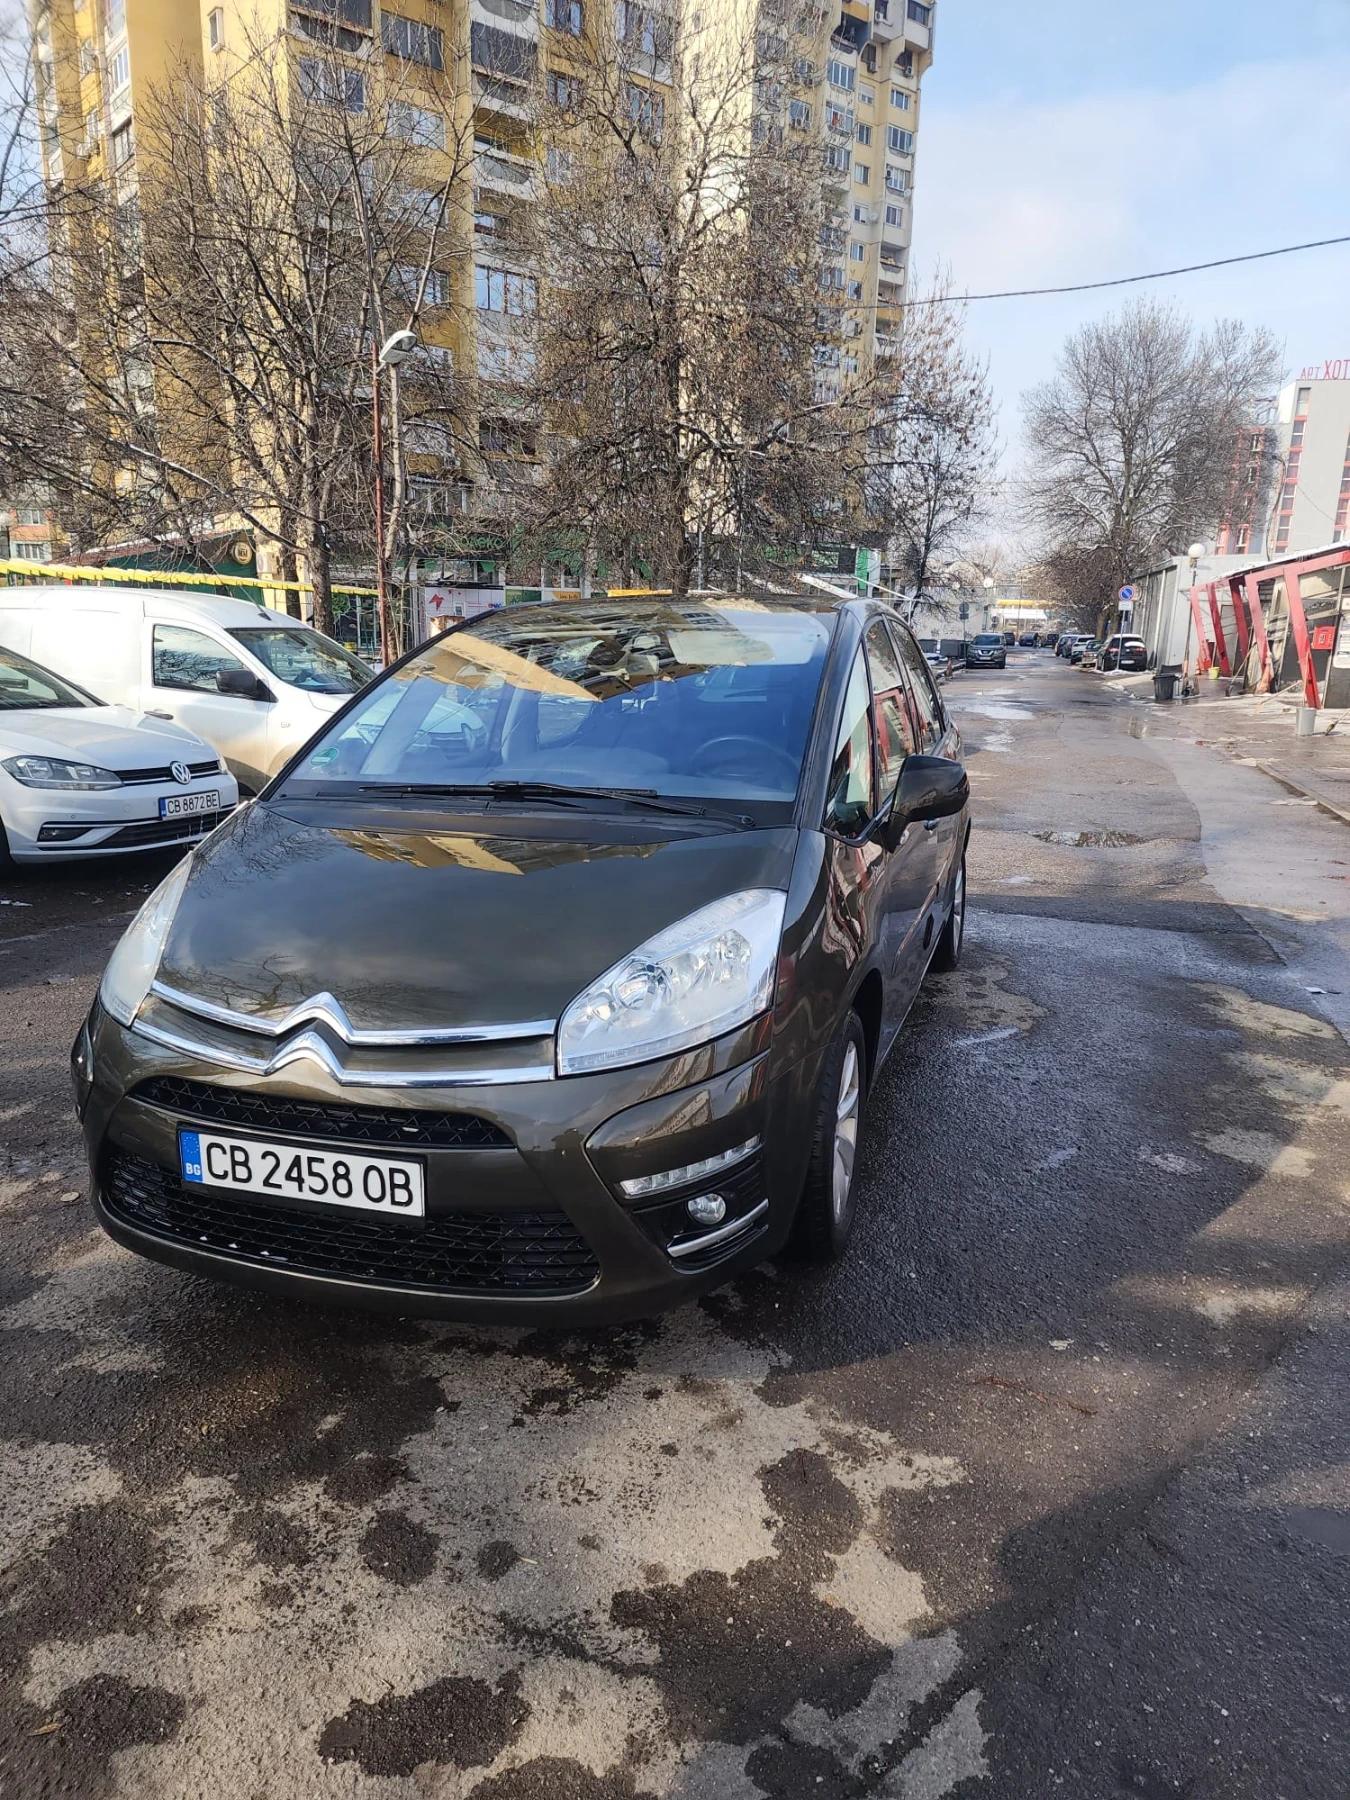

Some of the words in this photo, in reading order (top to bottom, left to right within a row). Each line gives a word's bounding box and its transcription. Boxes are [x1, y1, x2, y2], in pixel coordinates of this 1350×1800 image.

[1300, 367, 1321, 380] АРТ
[167, 799, 181, 814] CB
[183, 796, 205, 812] 8872
[206, 794, 217, 808] BE
[185, 1162, 201, 1176] BG
[206, 1142, 252, 1184] CB
[261, 1150, 354, 1198] 2458
[363, 1165, 414, 1208] OB
